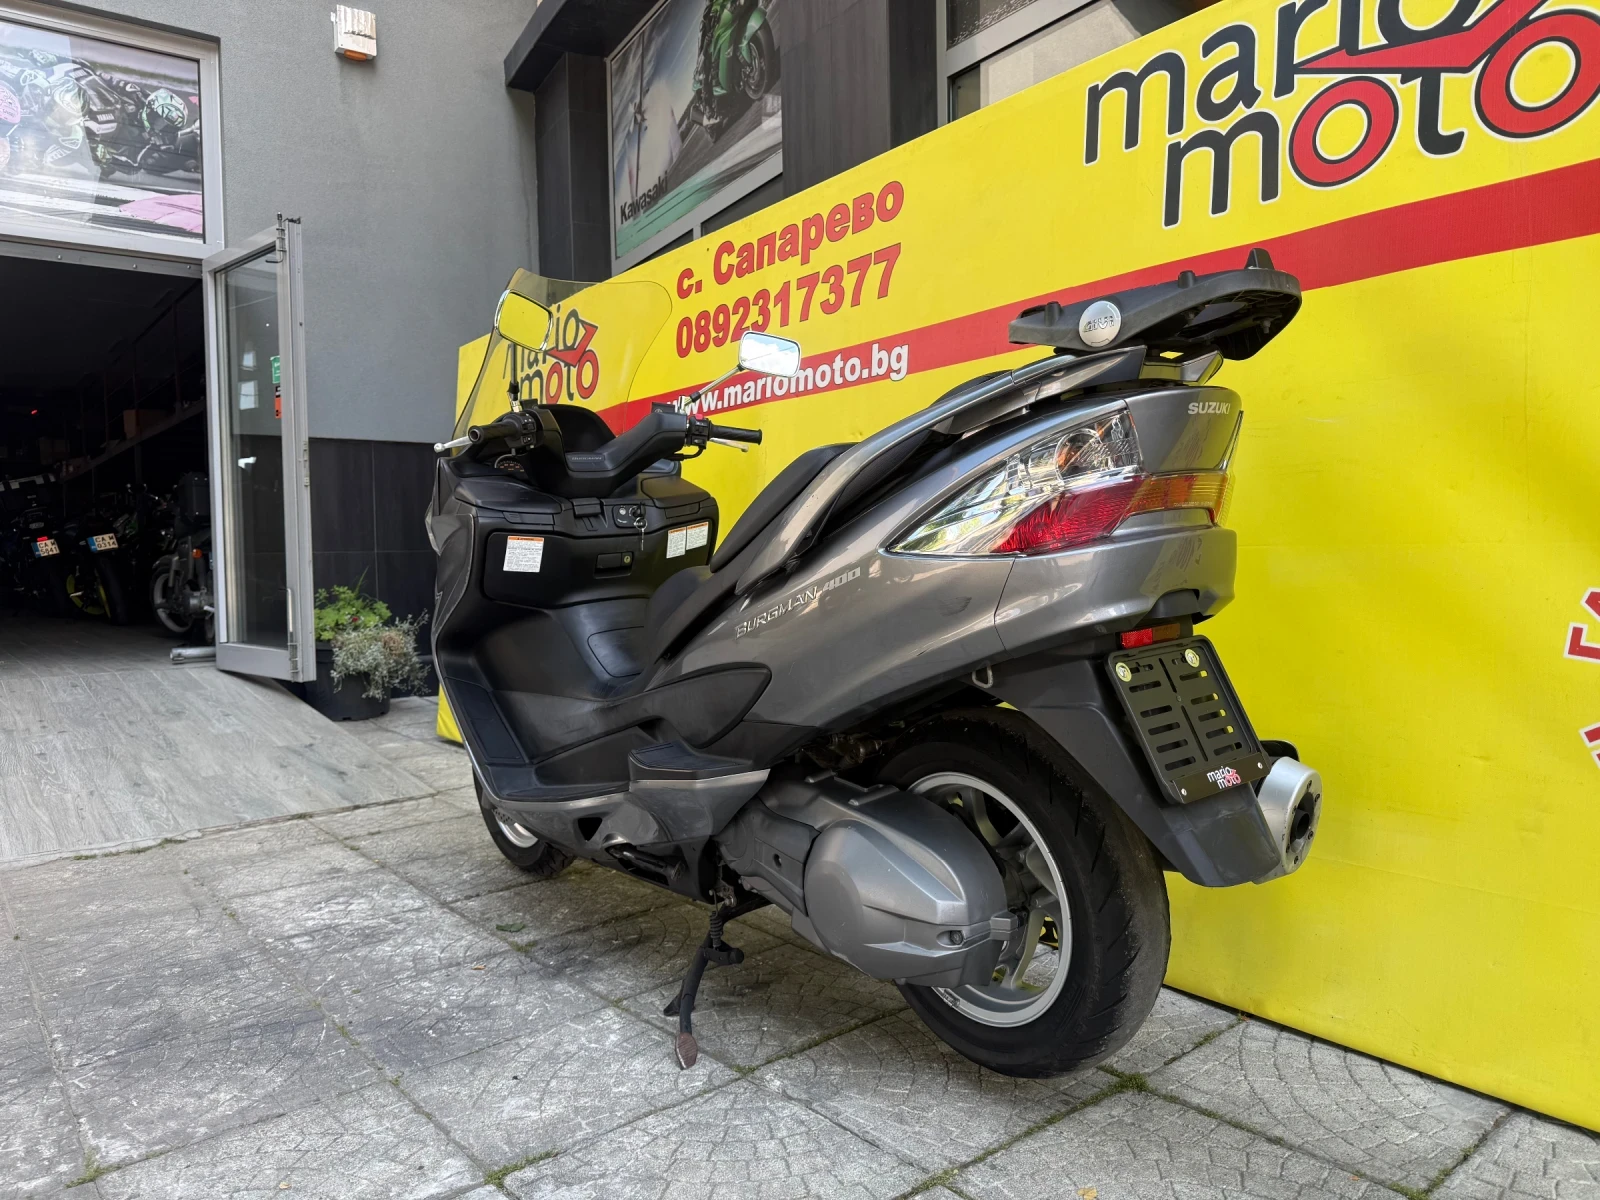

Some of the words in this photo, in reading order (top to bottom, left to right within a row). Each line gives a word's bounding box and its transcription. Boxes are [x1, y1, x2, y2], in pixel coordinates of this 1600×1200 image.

[1163, 8, 1600, 228] moto
[620, 169, 669, 225] Kawasaki
[676, 267, 703, 299] с.
[713, 180, 905, 286] Сапарево
[675, 242, 902, 359] 0892317377
[503, 304, 580, 380] aio
[519, 348, 600, 405] moto
[666, 342, 910, 416] ww.mariomoto.bg
[1187, 401, 1231, 415] SUZUKI
[734, 585, 820, 640] BURGMAN
[822, 566, 861, 593] 400
[1206, 766, 1233, 782] mario
[1216, 772, 1242, 789] moto
